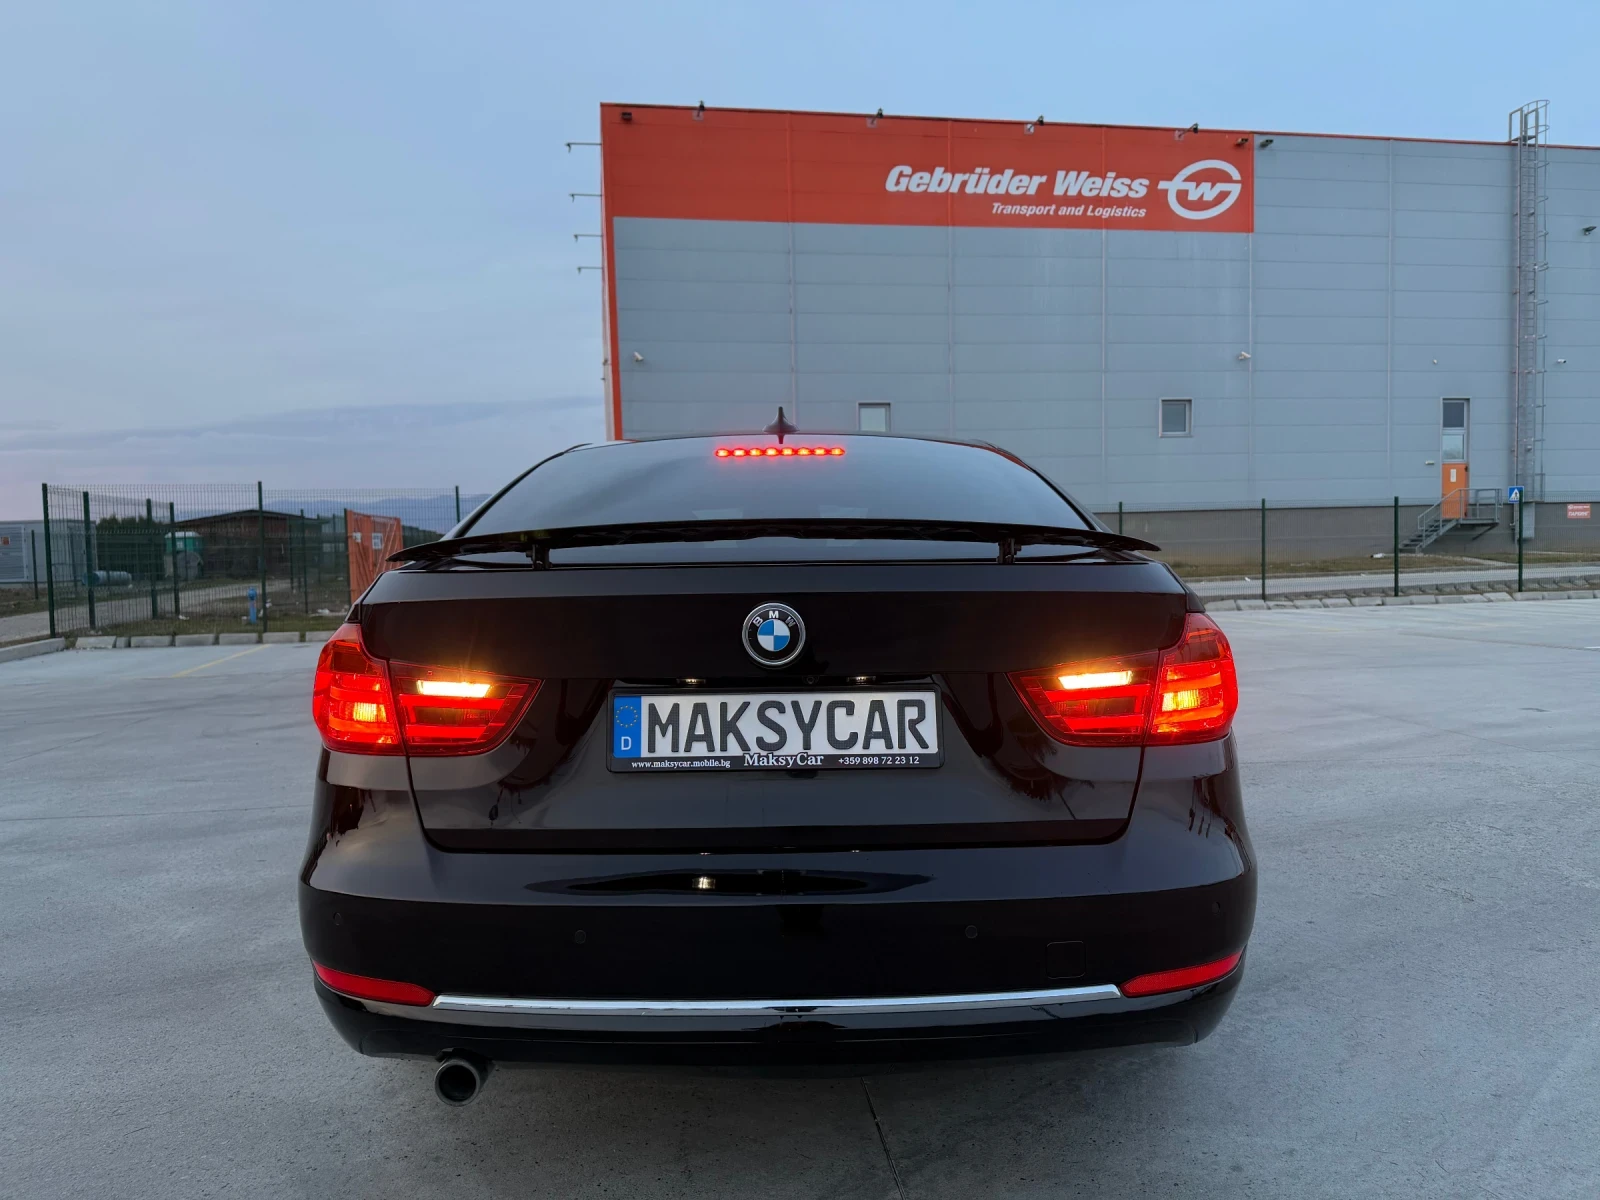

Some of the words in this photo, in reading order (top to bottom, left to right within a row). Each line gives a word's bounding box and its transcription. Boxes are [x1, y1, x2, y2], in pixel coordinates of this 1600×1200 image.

[885, 165, 1048, 196] Gebrüder
[1053, 170, 1150, 199] Weiss
[991, 202, 1055, 217] Transport
[1058, 204, 1083, 217] and
[1086, 204, 1147, 219] Logistics
[752, 610, 796, 628] BMW
[621, 736, 632, 750] D
[647, 699, 930, 753] MAKSYCAR
[631, 759, 731, 769] www.maksycar.mobile.bg
[743, 752, 824, 768] MaksyCar
[838, 756, 861, 765] +359
[862, 756, 879, 765] 898
[881, 756, 893, 765] 72
[894, 756, 906, 764] 23
[909, 756, 920, 764] 12
